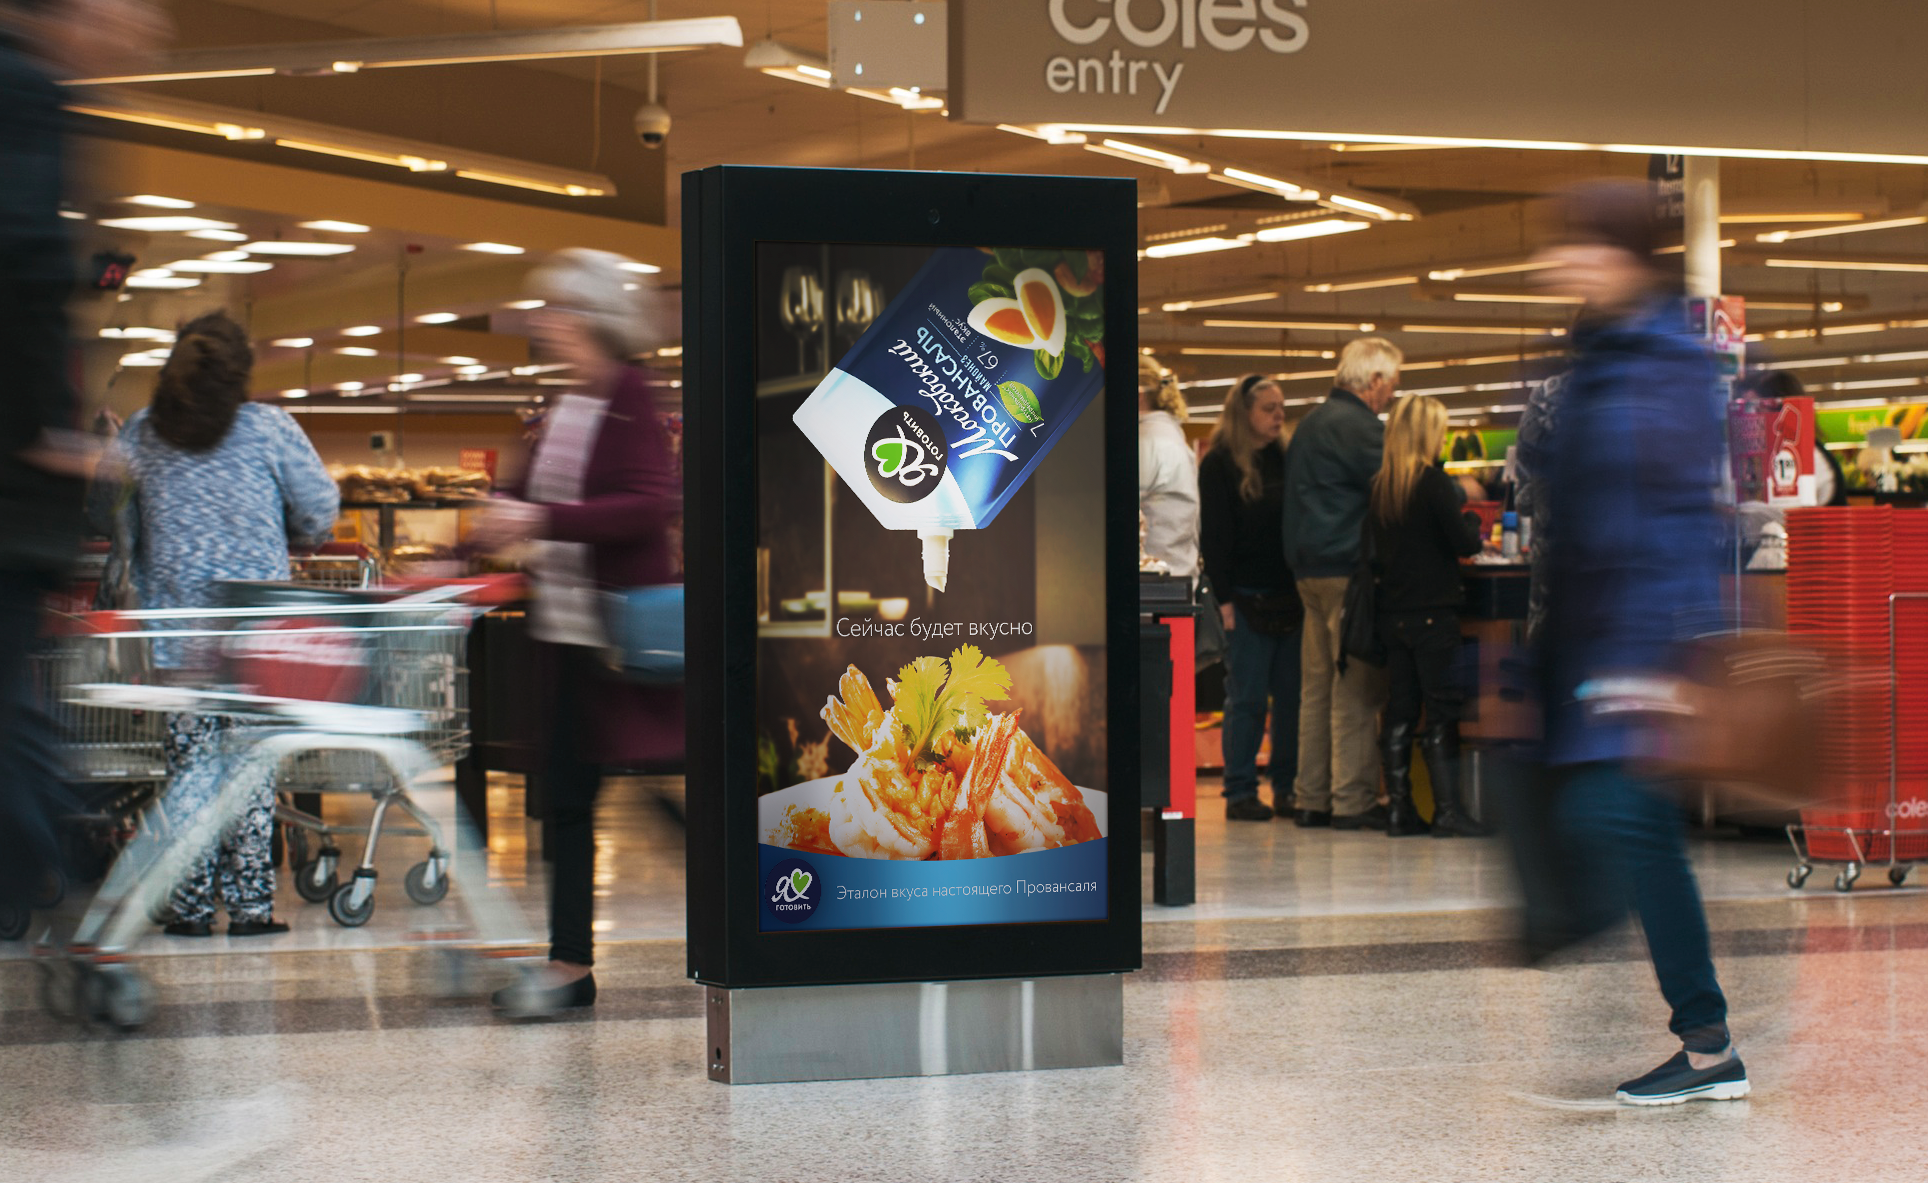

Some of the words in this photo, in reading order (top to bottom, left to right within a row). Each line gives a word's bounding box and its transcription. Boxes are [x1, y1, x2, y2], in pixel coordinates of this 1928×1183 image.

[1046, 50, 1184, 115] entry
[916, 326, 1017, 449] ПРОВАНСАЛЬ
[960, 354, 992, 392] МАЙОНЕЗ
[887, 339, 1019, 462] Московский
[1030, 422, 1045, 438] 7
[836, 617, 905, 637] Сейчас
[910, 617, 963, 641] будет
[969, 621, 1033, 640] вкусно
[836, 885, 887, 900] Эталон
[891, 887, 928, 901] вкуса
[932, 883, 1012, 897] настоящего
[1016, 879, 1097, 897] Провансаля
